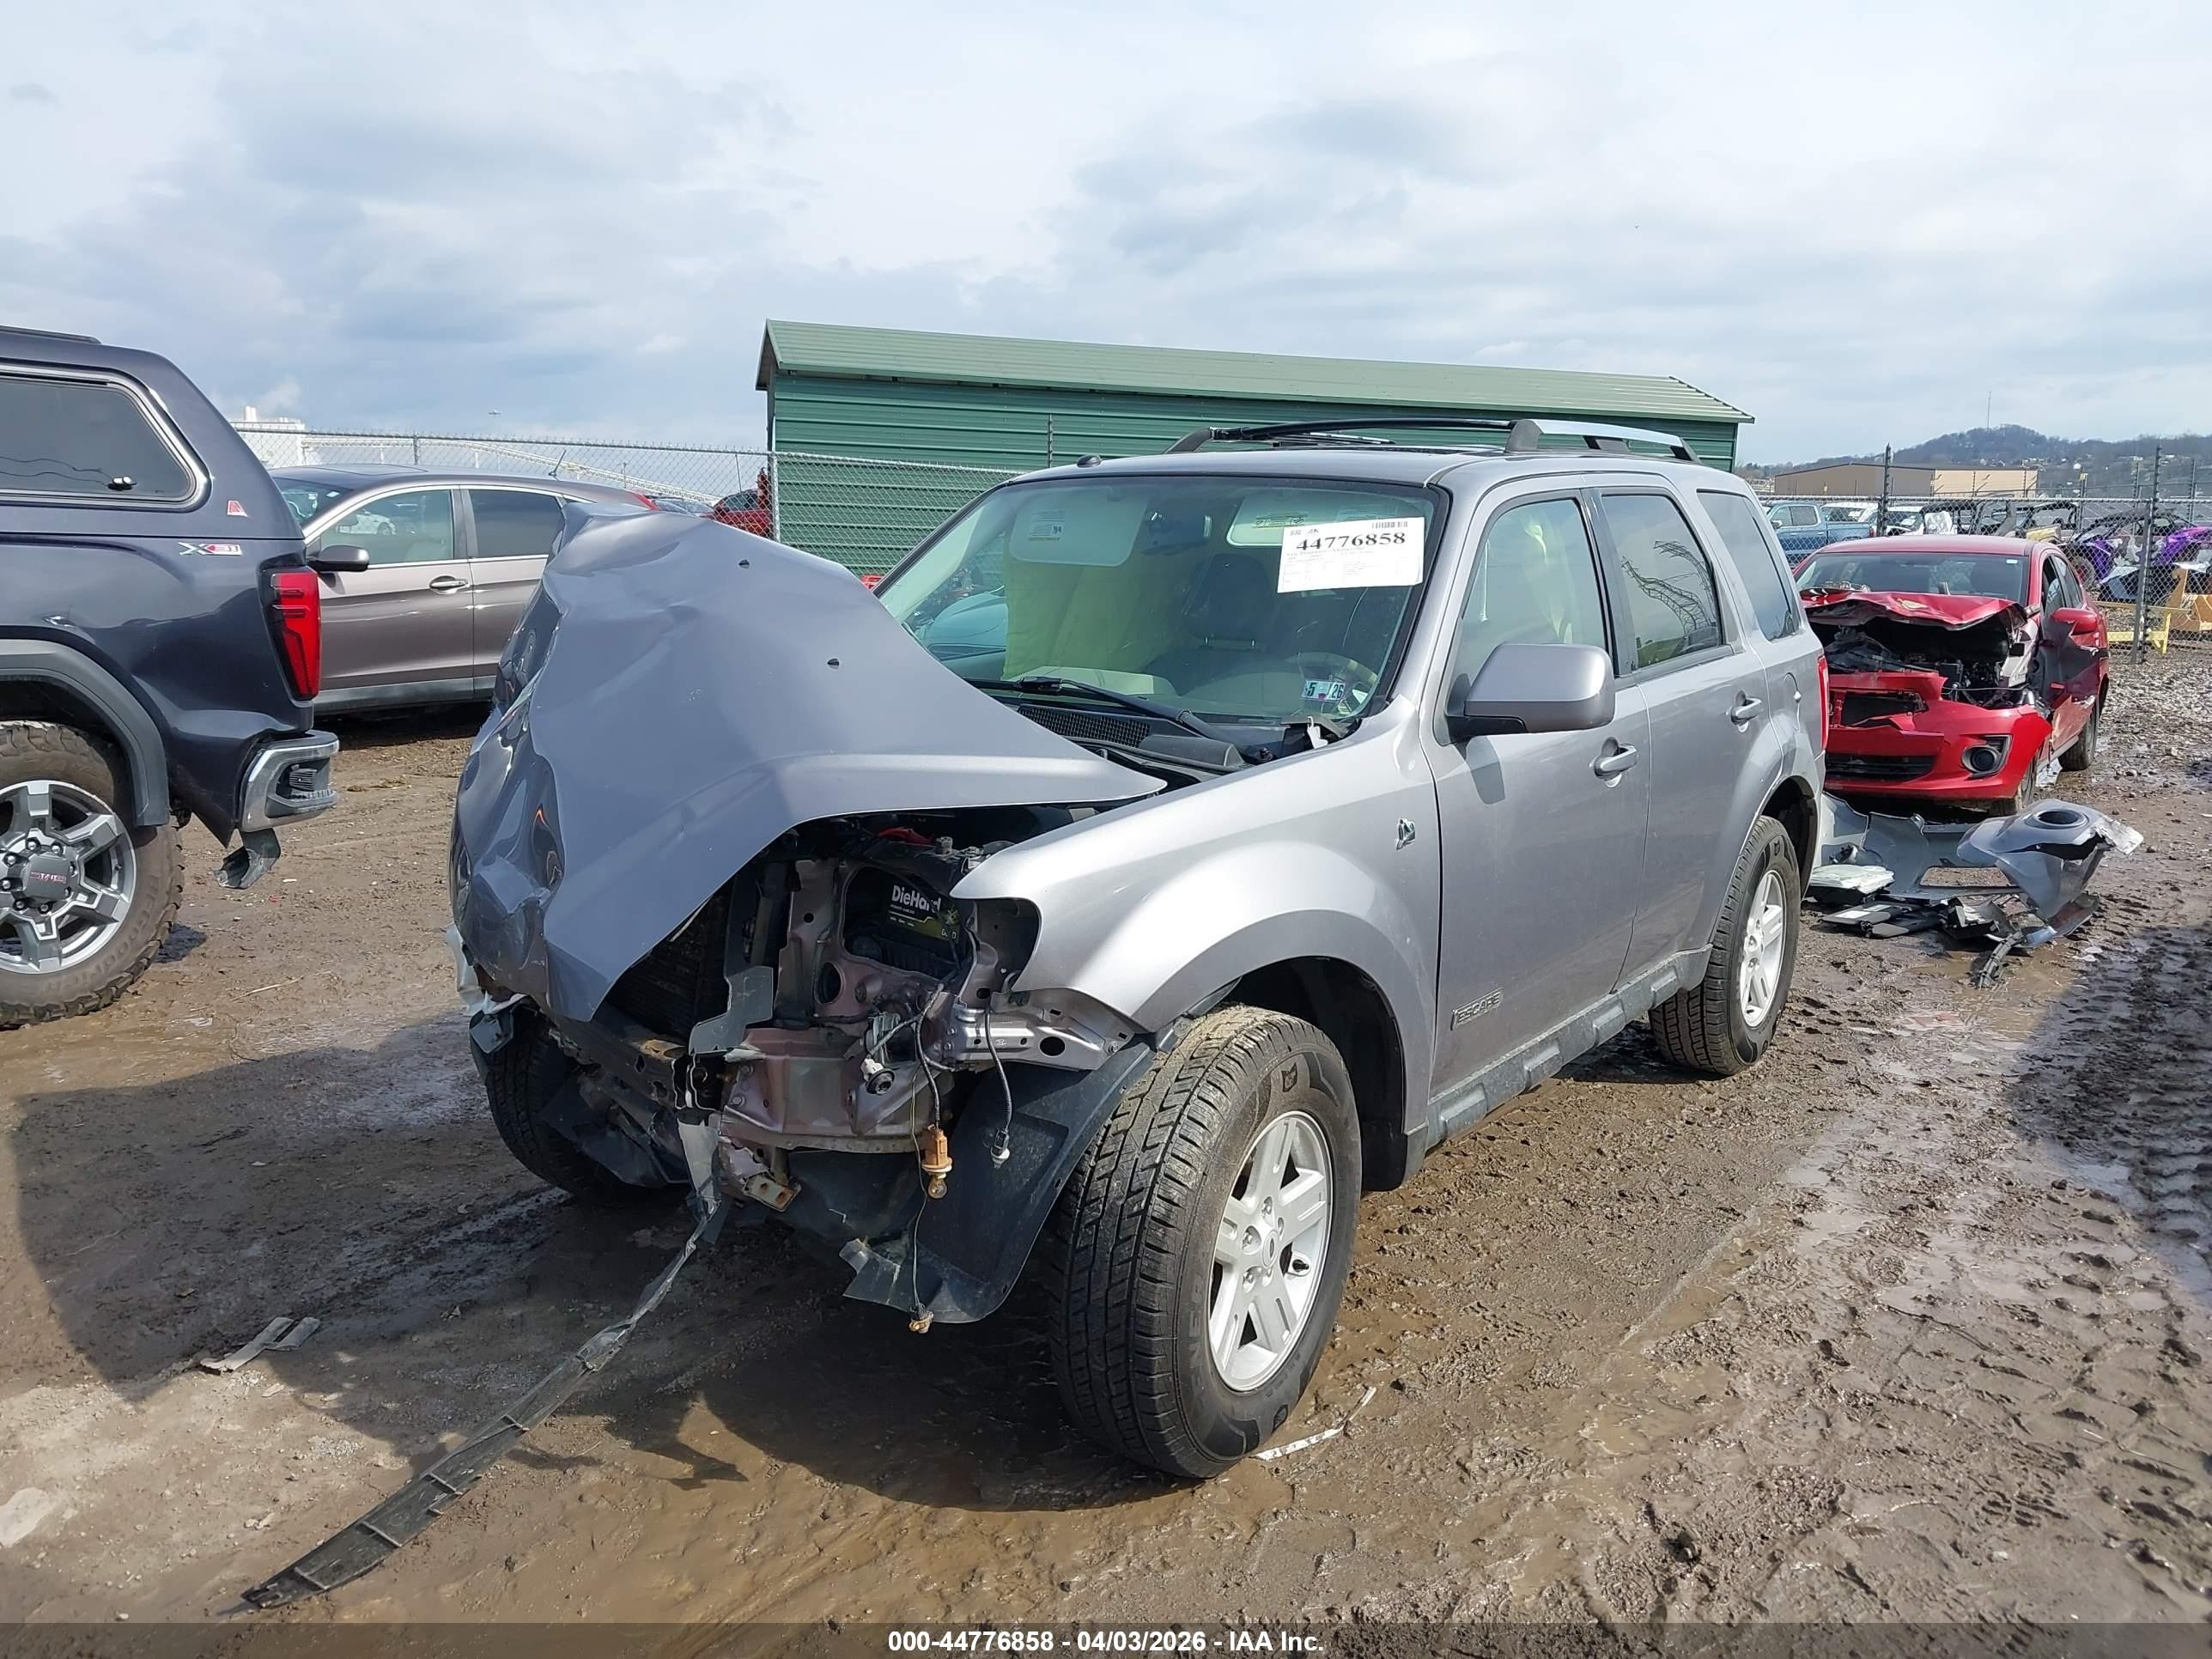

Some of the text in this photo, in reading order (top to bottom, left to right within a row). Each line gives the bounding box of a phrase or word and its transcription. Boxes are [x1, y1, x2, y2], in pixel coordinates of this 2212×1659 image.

[1295, 532, 1407, 551] 44776858
[1331, 684, 1345, 698] 26
[941, 928, 957, 940] GD
